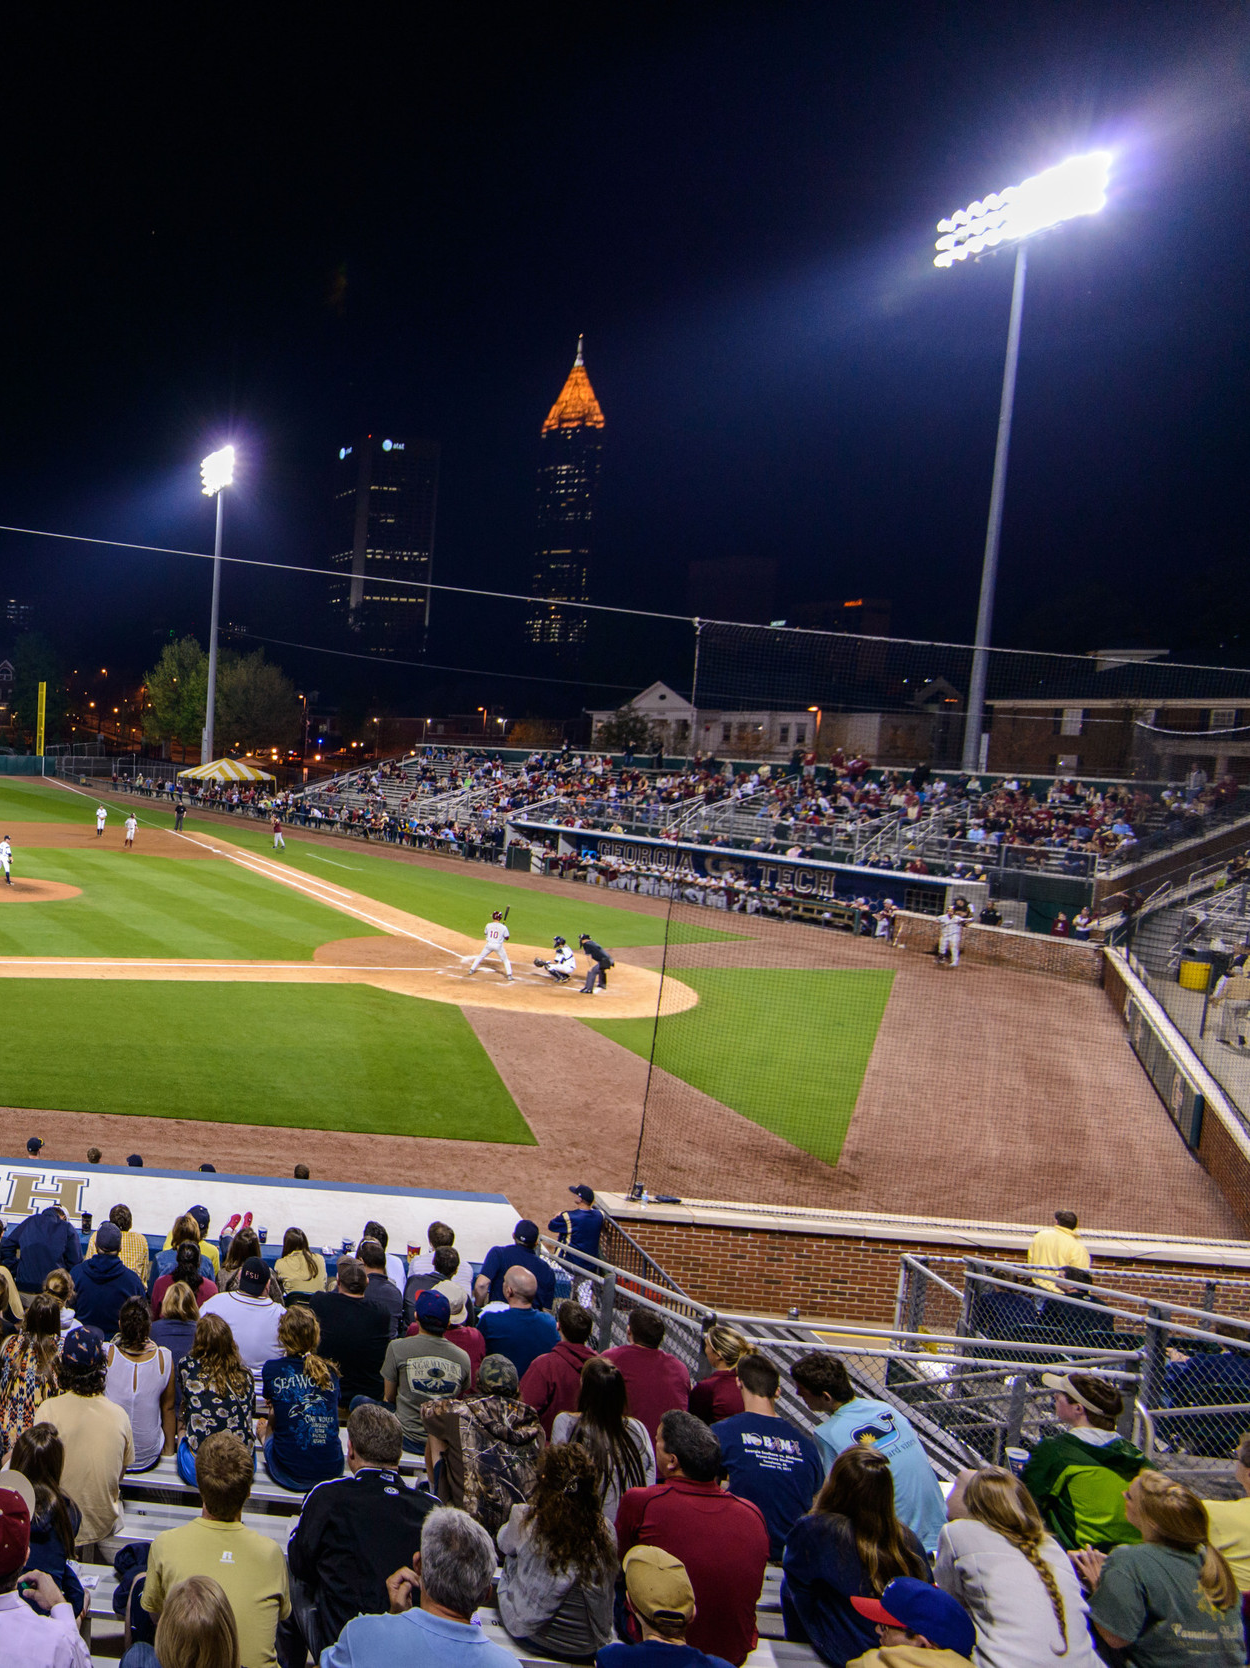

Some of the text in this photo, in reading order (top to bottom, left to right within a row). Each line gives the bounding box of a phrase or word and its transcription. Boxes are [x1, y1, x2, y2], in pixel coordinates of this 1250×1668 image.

[597, 839, 695, 874] GEORGIA
[757, 861, 836, 898] TECH
[490, 930, 499, 939] 10
[245, 1270, 259, 1279] FSU
[273, 1374, 335, 1394] SEAWOD
